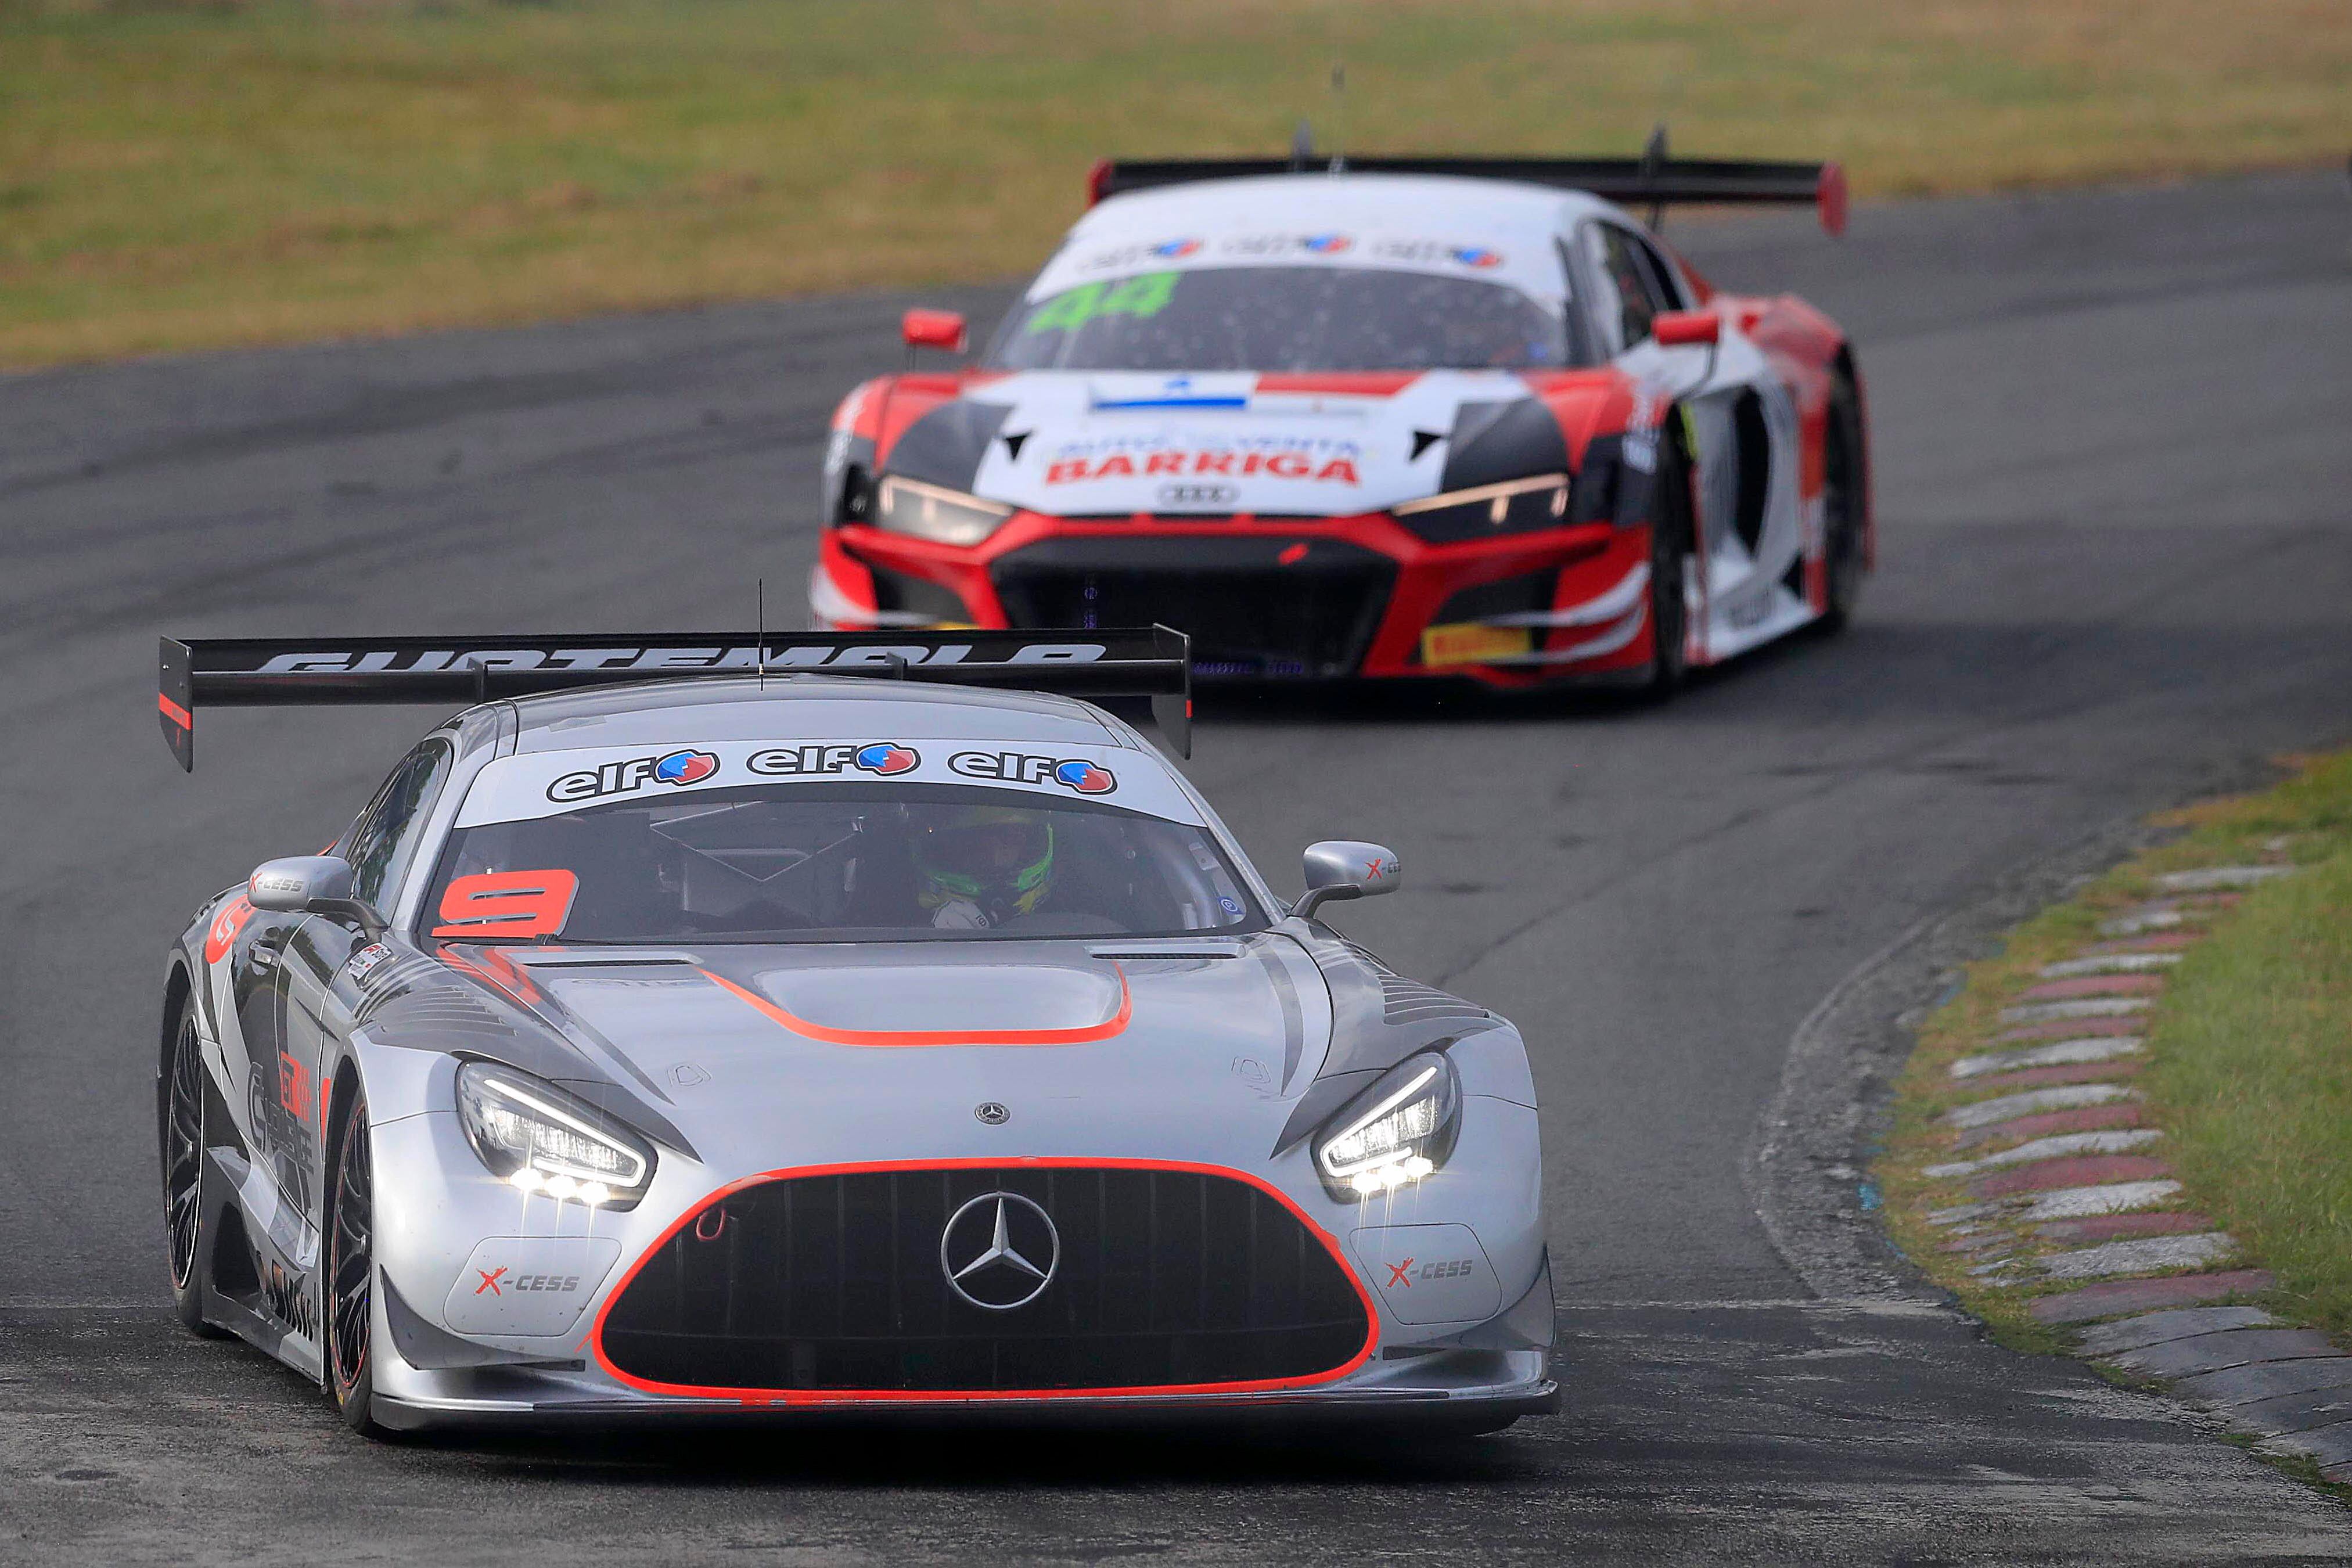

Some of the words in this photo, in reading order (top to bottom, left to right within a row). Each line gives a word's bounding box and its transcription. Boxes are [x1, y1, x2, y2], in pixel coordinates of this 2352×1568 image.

[1026, 271, 1181, 332] 44
[1044, 452, 1358, 485] BARRIGA
[257, 643, 1107, 672] GUATEMALA
[547, 760, 656, 803] elf
[746, 748, 856, 776] elf
[947, 750, 1059, 785] elf
[475, 1266, 580, 1296] X-CESS
[1384, 1257, 1473, 1289] X-CESS
